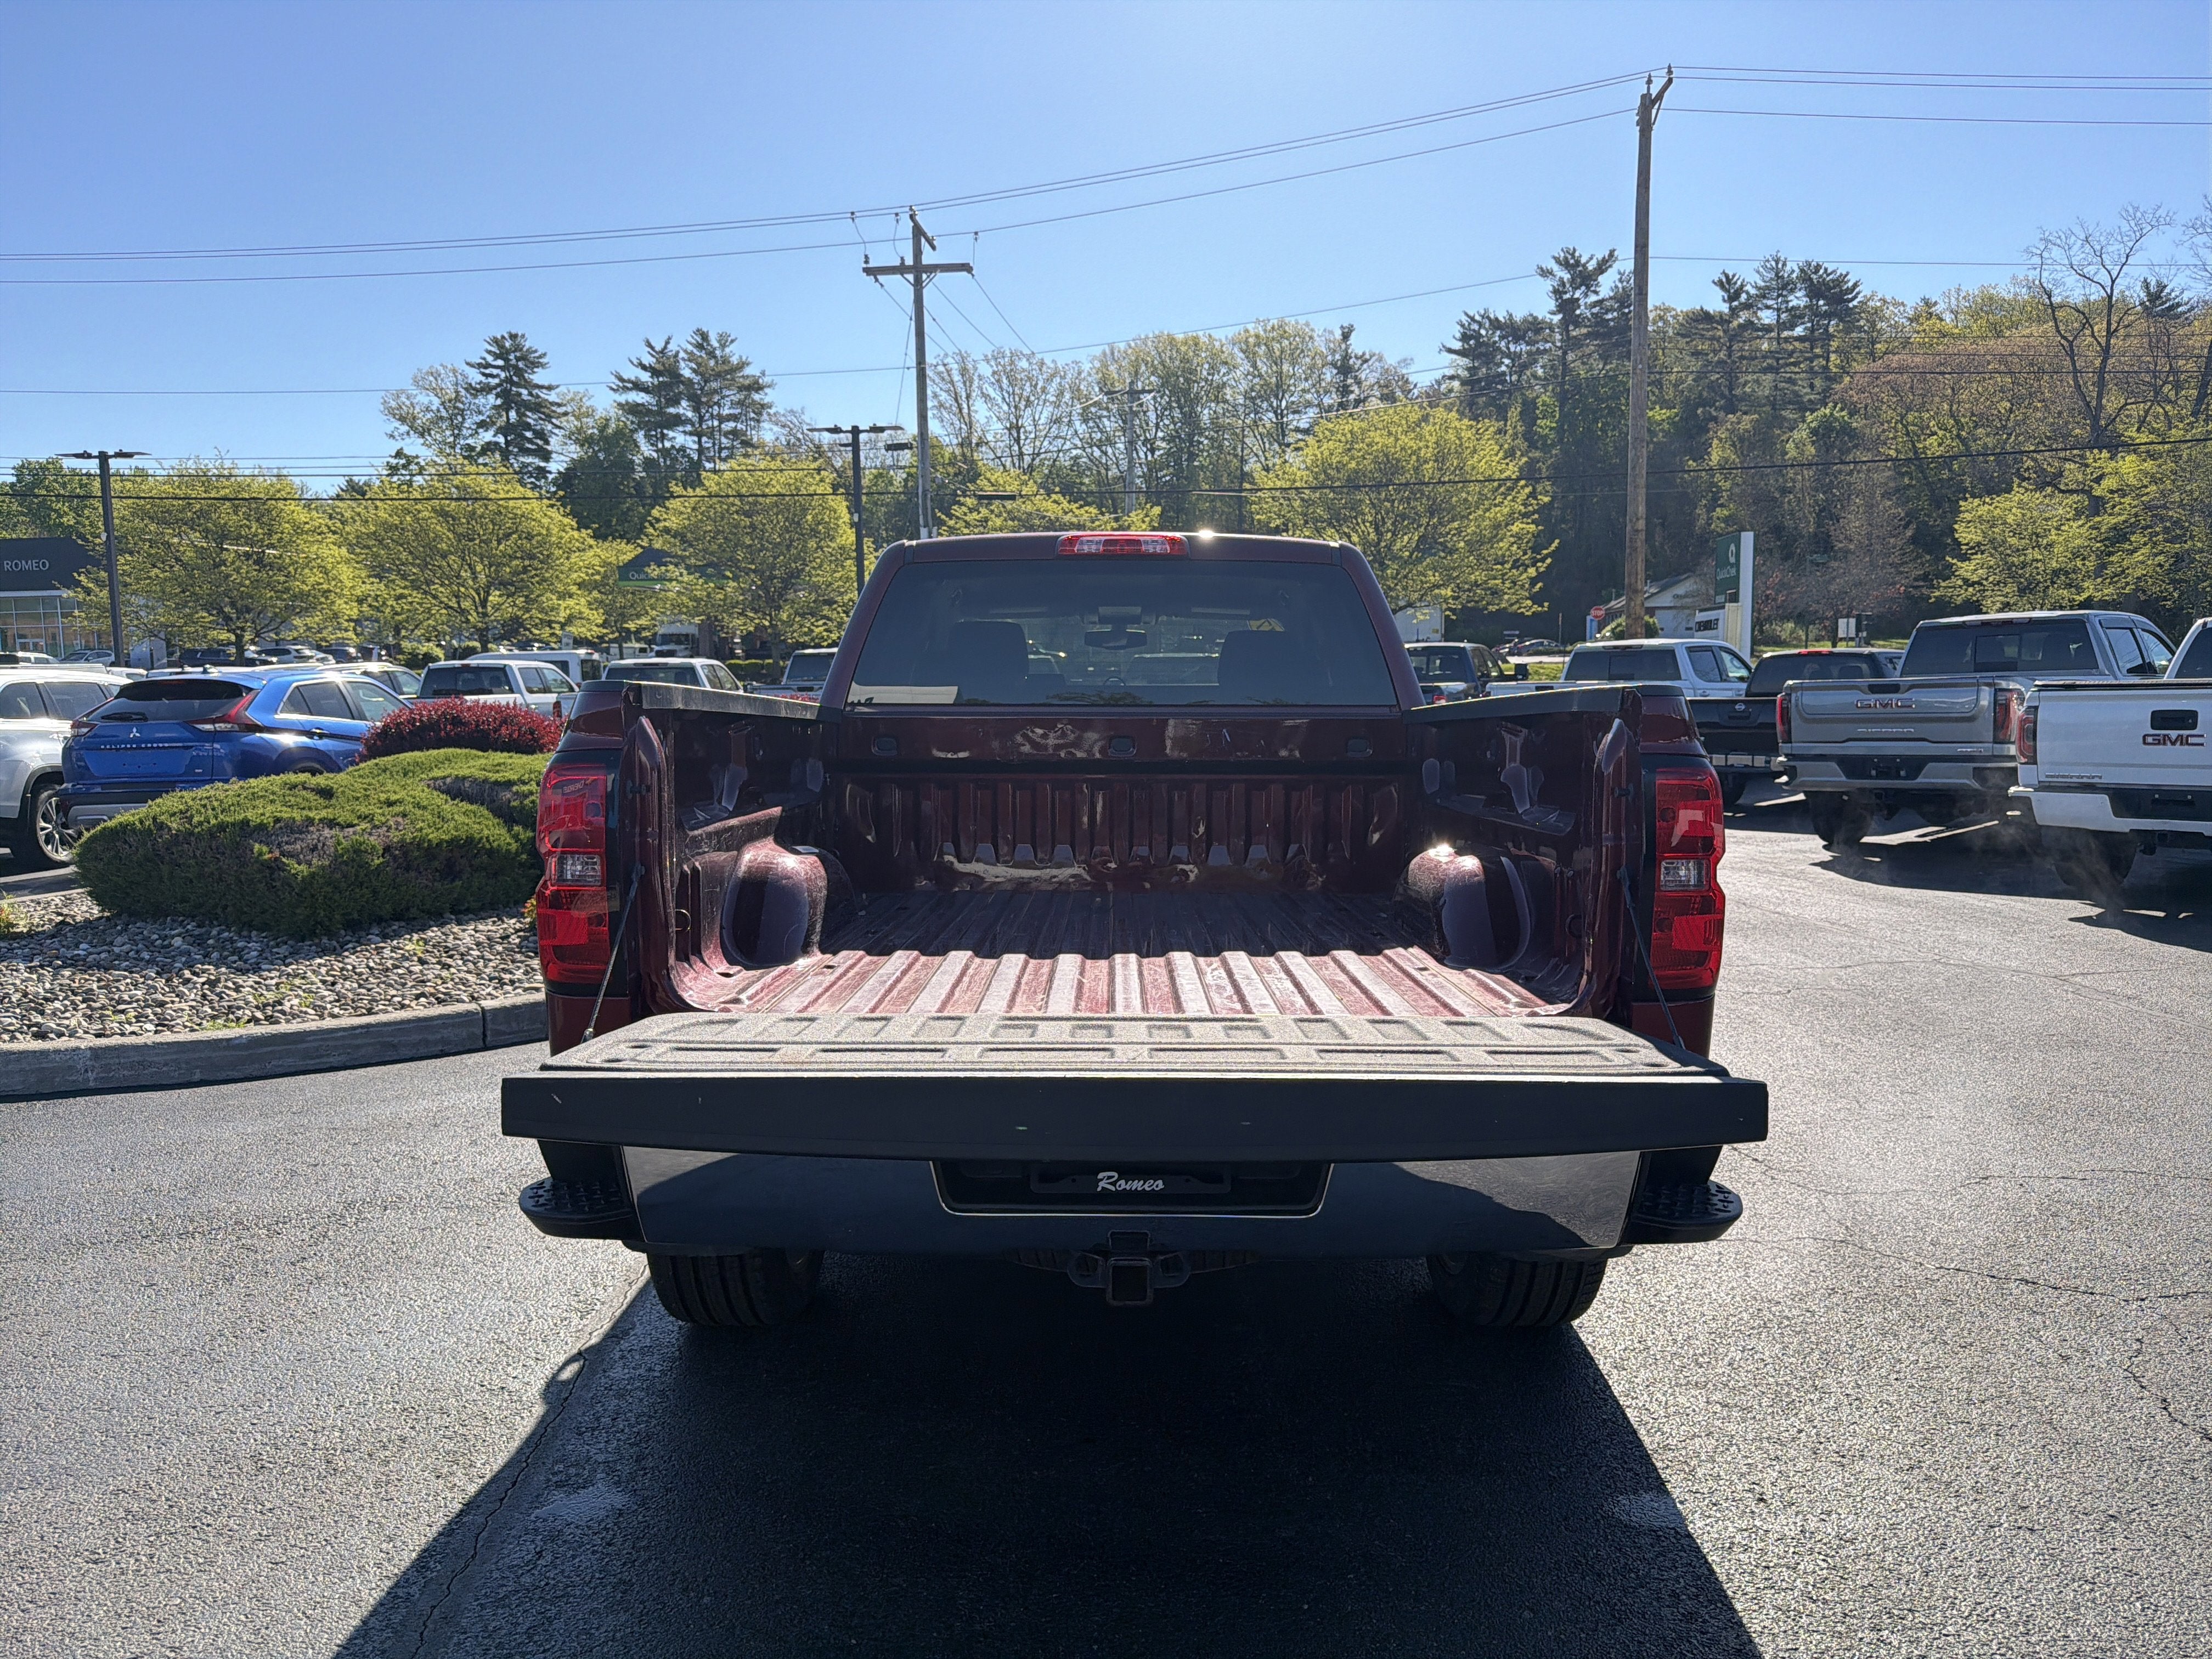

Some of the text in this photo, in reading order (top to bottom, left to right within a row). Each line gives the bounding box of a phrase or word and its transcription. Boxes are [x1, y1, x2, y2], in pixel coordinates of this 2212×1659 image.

[4, 560, 49, 571] ROMEO
[1855, 698, 1915, 709] GMC
[2142, 733, 2207, 747] GMC
[1097, 1171, 1165, 1192] Romeo
